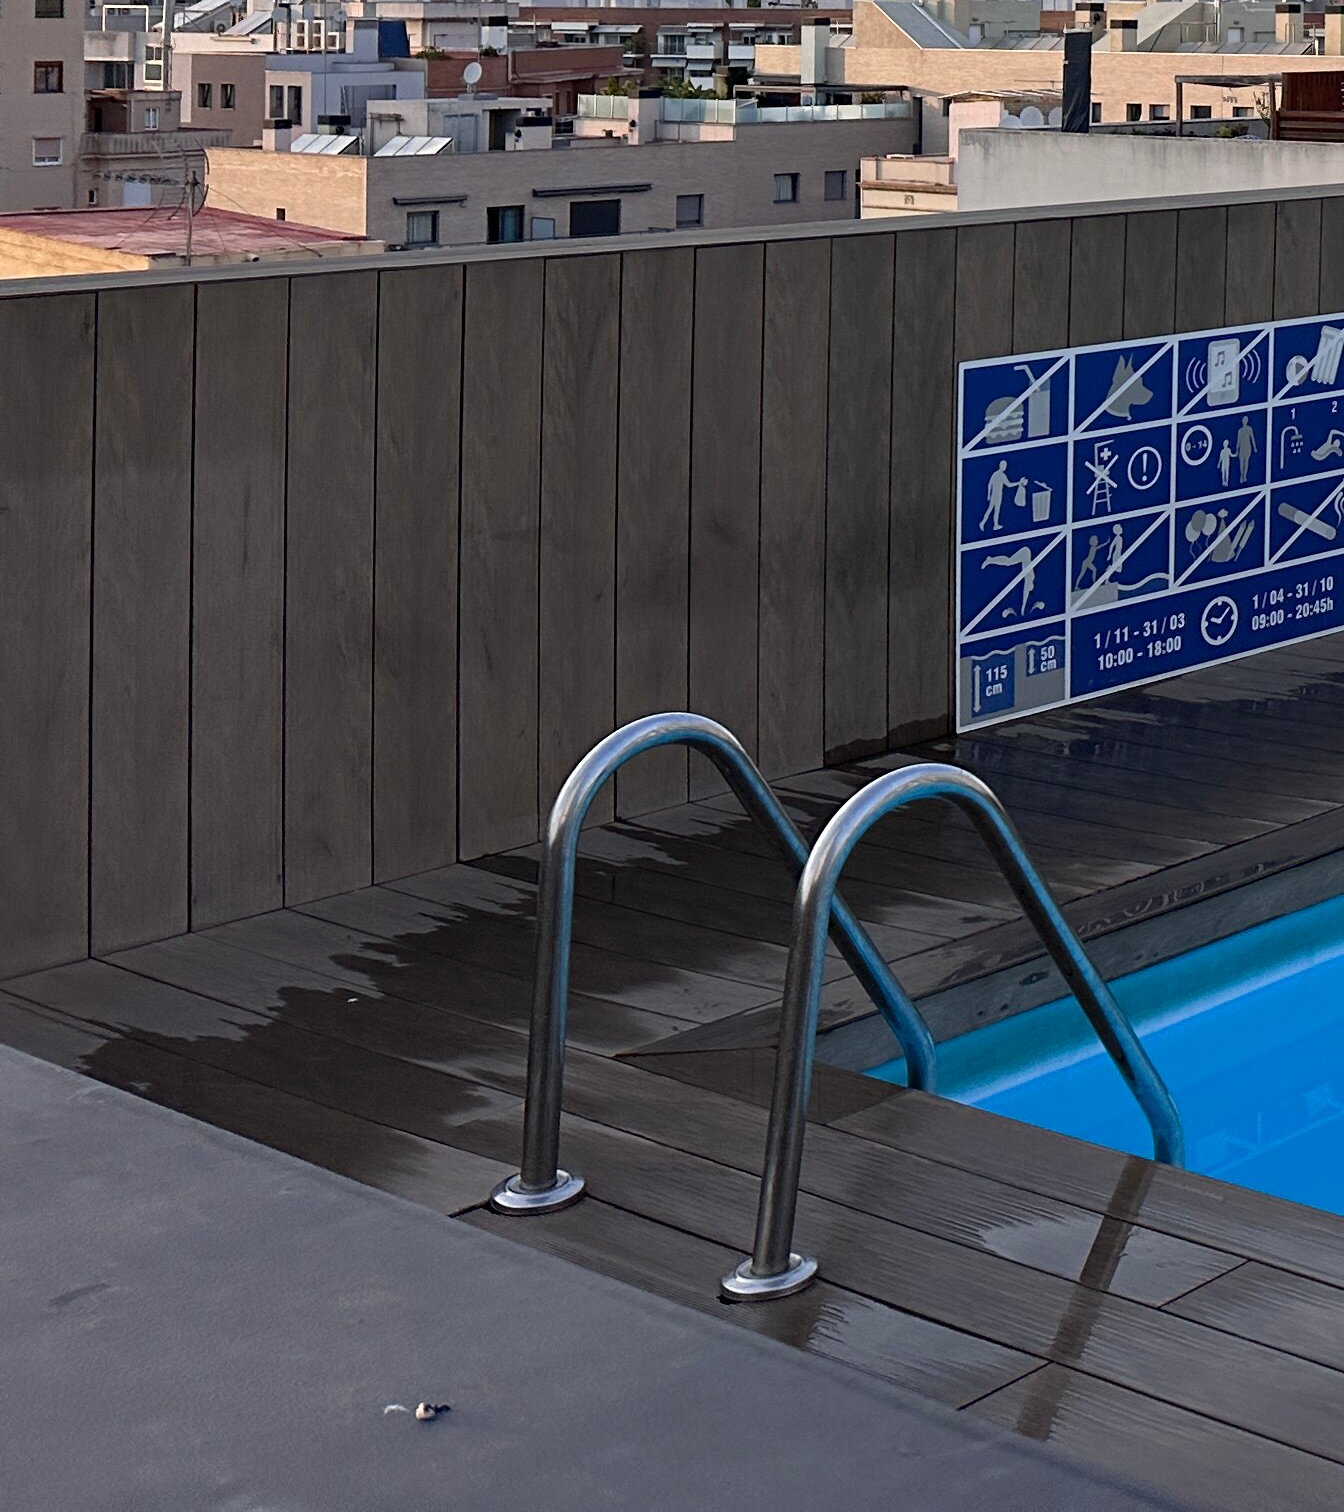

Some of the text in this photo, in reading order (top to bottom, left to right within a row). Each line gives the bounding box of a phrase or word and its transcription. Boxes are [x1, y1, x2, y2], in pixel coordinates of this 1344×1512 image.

[1291, 400, 1338, 420] 1 2
[1251, 609, 1284, 631] 09:00
[1295, 596, 1334, 619] 20:45h
[1040, 645, 1055, 661] 50
[1097, 647, 1134, 671] 10:00
[1147, 635, 1182, 658] 18:00
[985, 664, 1008, 683] 115
[1040, 658, 1057, 672] cm
[985, 682, 1003, 697] cm
